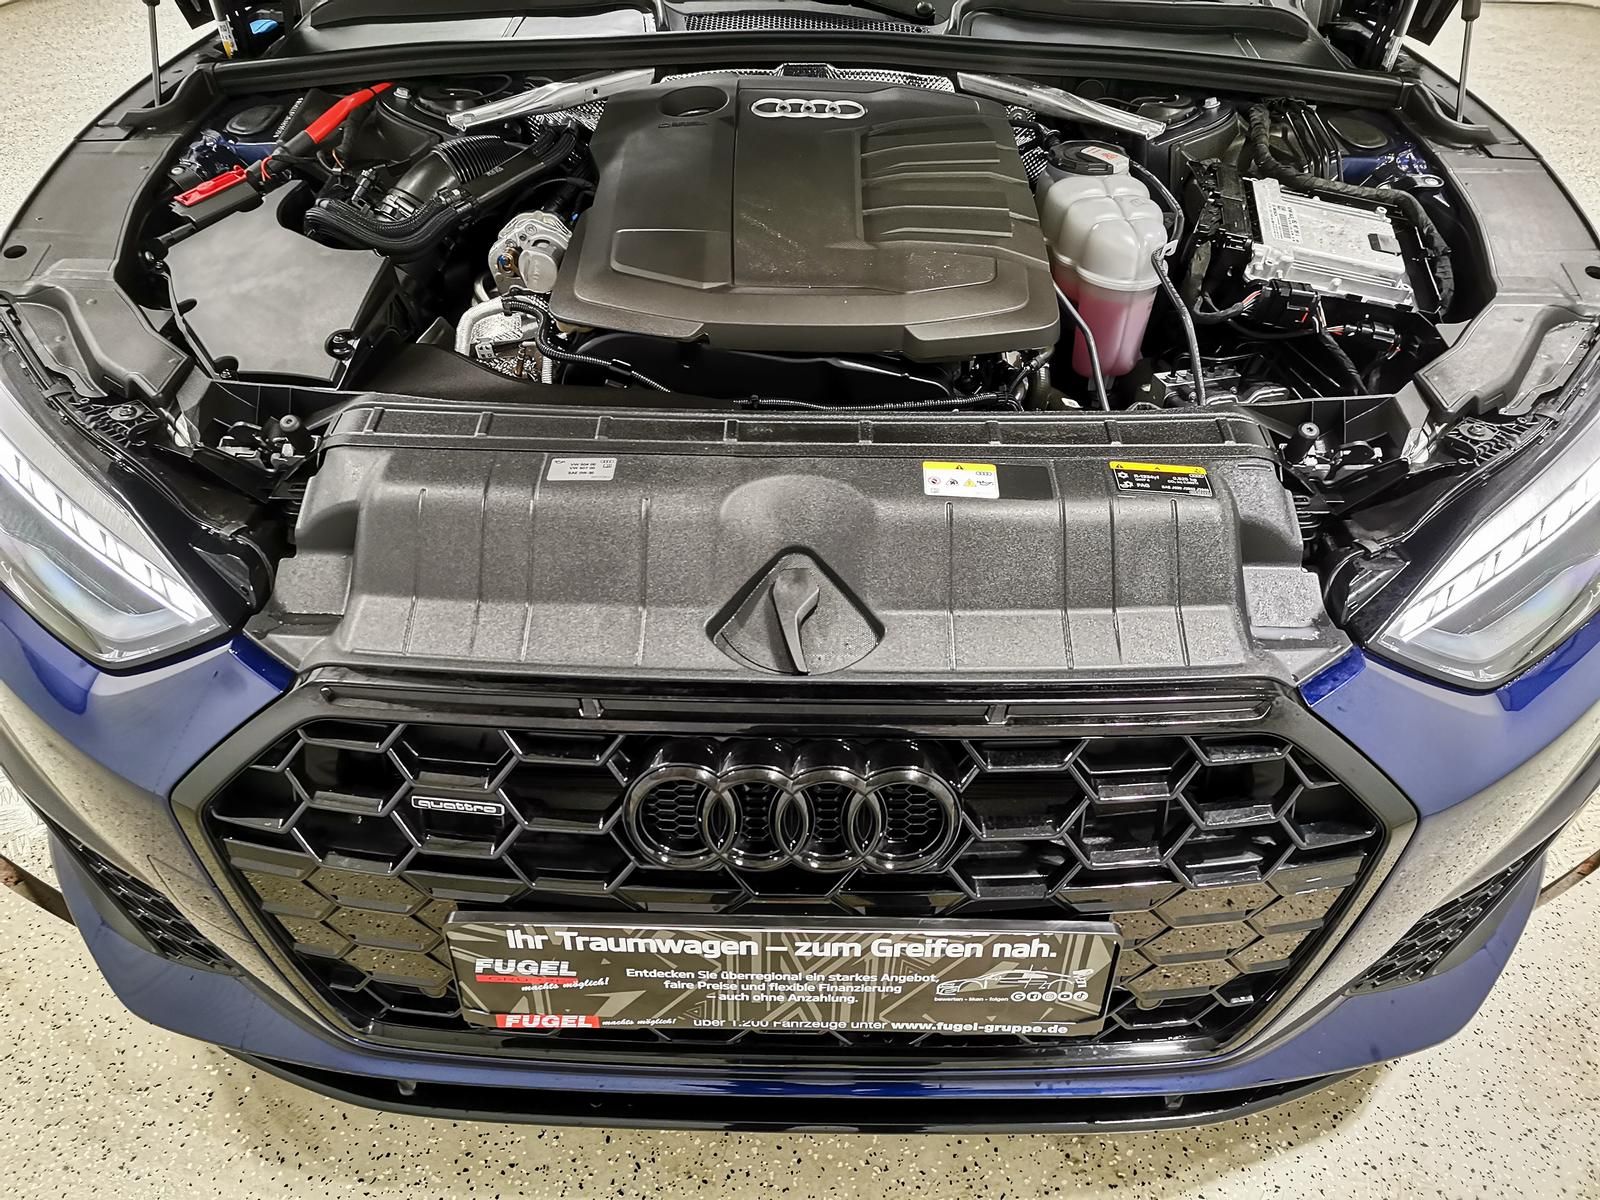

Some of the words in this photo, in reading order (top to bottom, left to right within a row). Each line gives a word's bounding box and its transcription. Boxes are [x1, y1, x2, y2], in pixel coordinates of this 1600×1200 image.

[418, 800, 497, 813] quattro
[506, 929, 548, 950] Ihr
[555, 931, 758, 958] Traumwagen
[794, 940, 862, 958] zum
[871, 938, 984, 958] Greifen
[992, 939, 1058, 958] nah.
[474, 958, 578, 976] FUGEL
[626, 968, 694, 979] Entdecken
[697, 970, 717, 979] Sie
[721, 971, 802, 982] überregional
[805, 973, 825, 982] ein
[828, 973, 878, 982] starkes
[880, 974, 940, 983] Angebot,
[522, 983, 560, 992] machts
[563, 977, 610, 990] möglich!
[663, 980, 695, 989] faire
[697, 981, 738, 990] Preise
[741, 982, 766, 990] und
[768, 983, 815, 992] flexible
[818, 983, 902, 993] Finanzierung
[718, 992, 749, 1001] auch
[752, 993, 784, 1002] ohne
[788, 994, 858, 1004] Anzahlung.
[505, 1015, 593, 1028] FUGEL
[850, 1021, 887, 1030] unter
[890, 1021, 1068, 1035] www.fugel-gruppe.de
